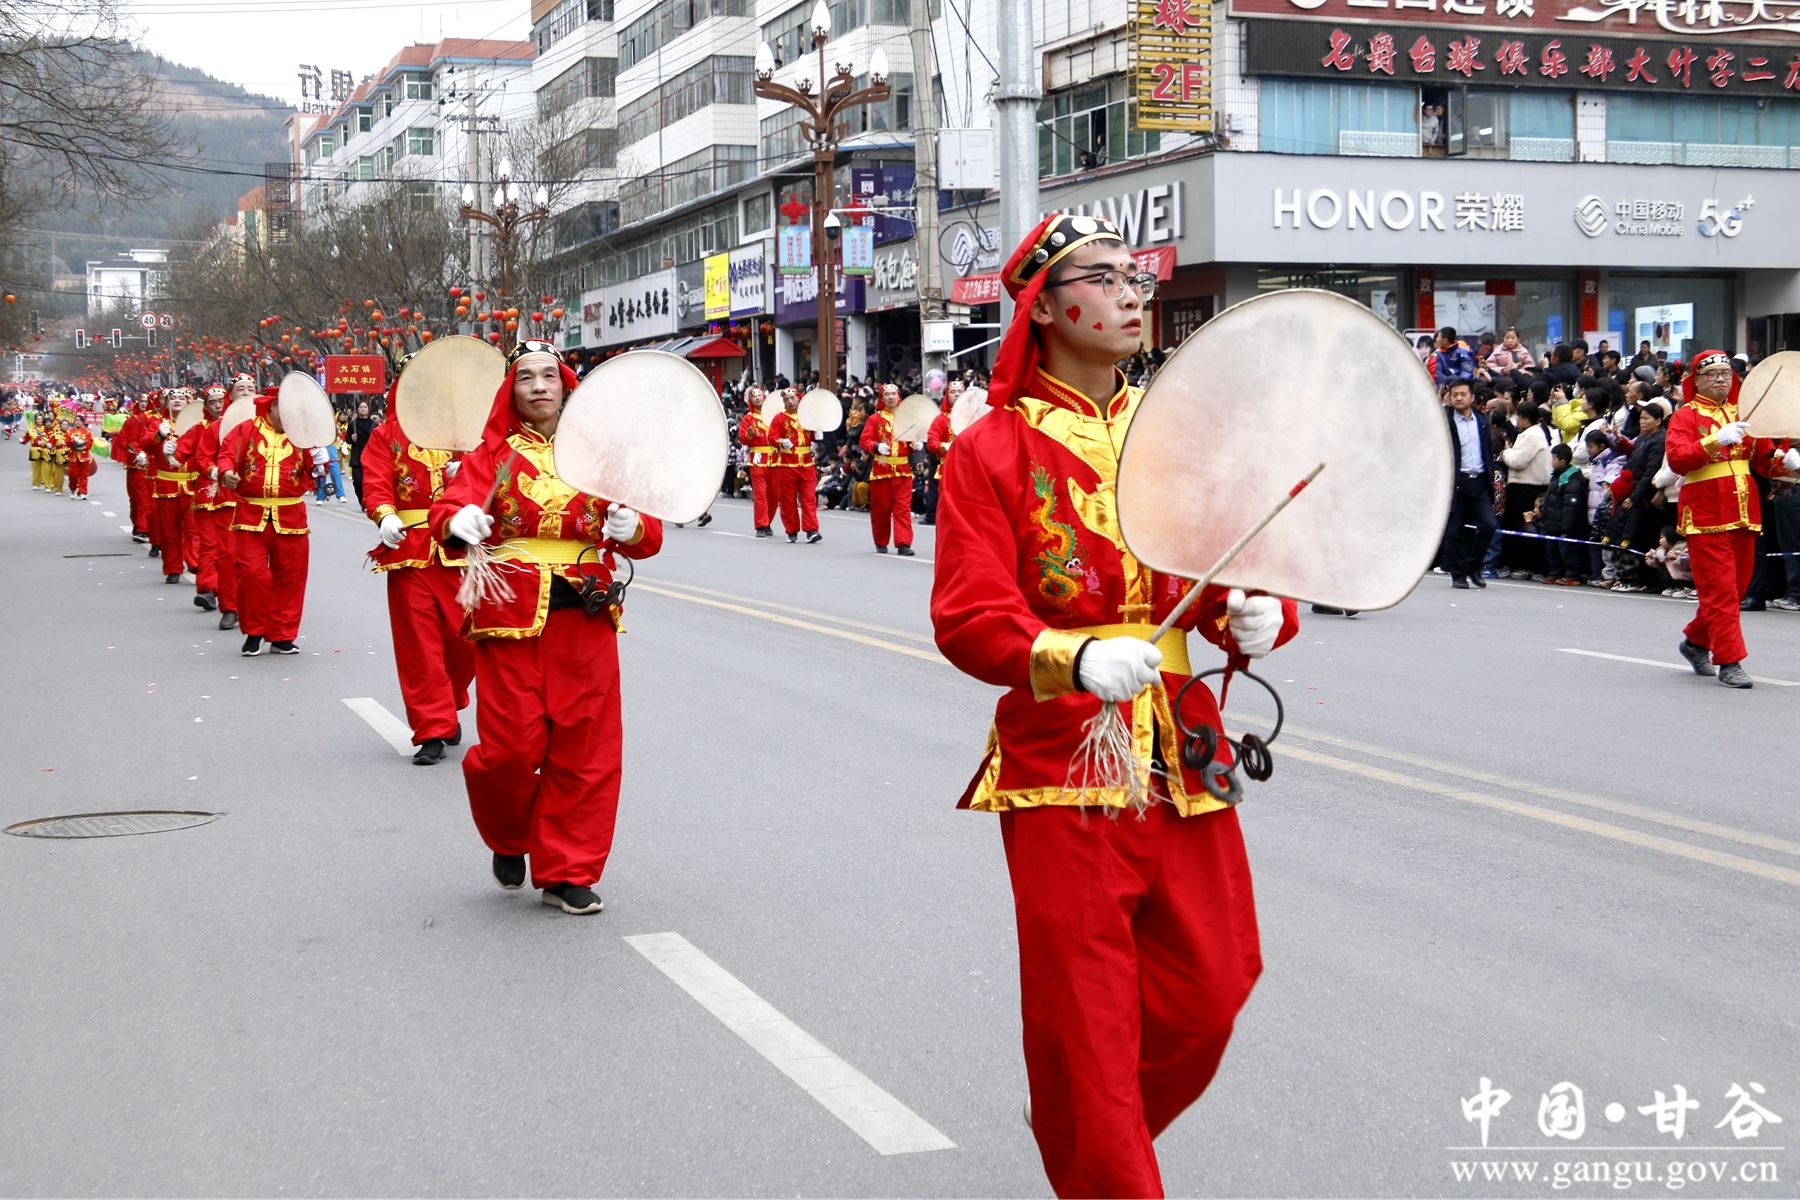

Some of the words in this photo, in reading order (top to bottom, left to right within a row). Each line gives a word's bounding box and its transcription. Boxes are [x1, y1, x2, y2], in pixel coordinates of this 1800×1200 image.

[1152, 63, 1203, 102] 2F
[1040, 181, 1184, 246] WEI
[1274, 188, 1446, 231] HONOR
[1454, 191, 1525, 232] 荣耀
[1615, 200, 1684, 221] 中国移动
[1615, 222, 1647, 236] China
[1650, 223, 1684, 236] Mobile
[143, 316, 154, 324] 40
[340, 365, 370, 373] 大石镇
